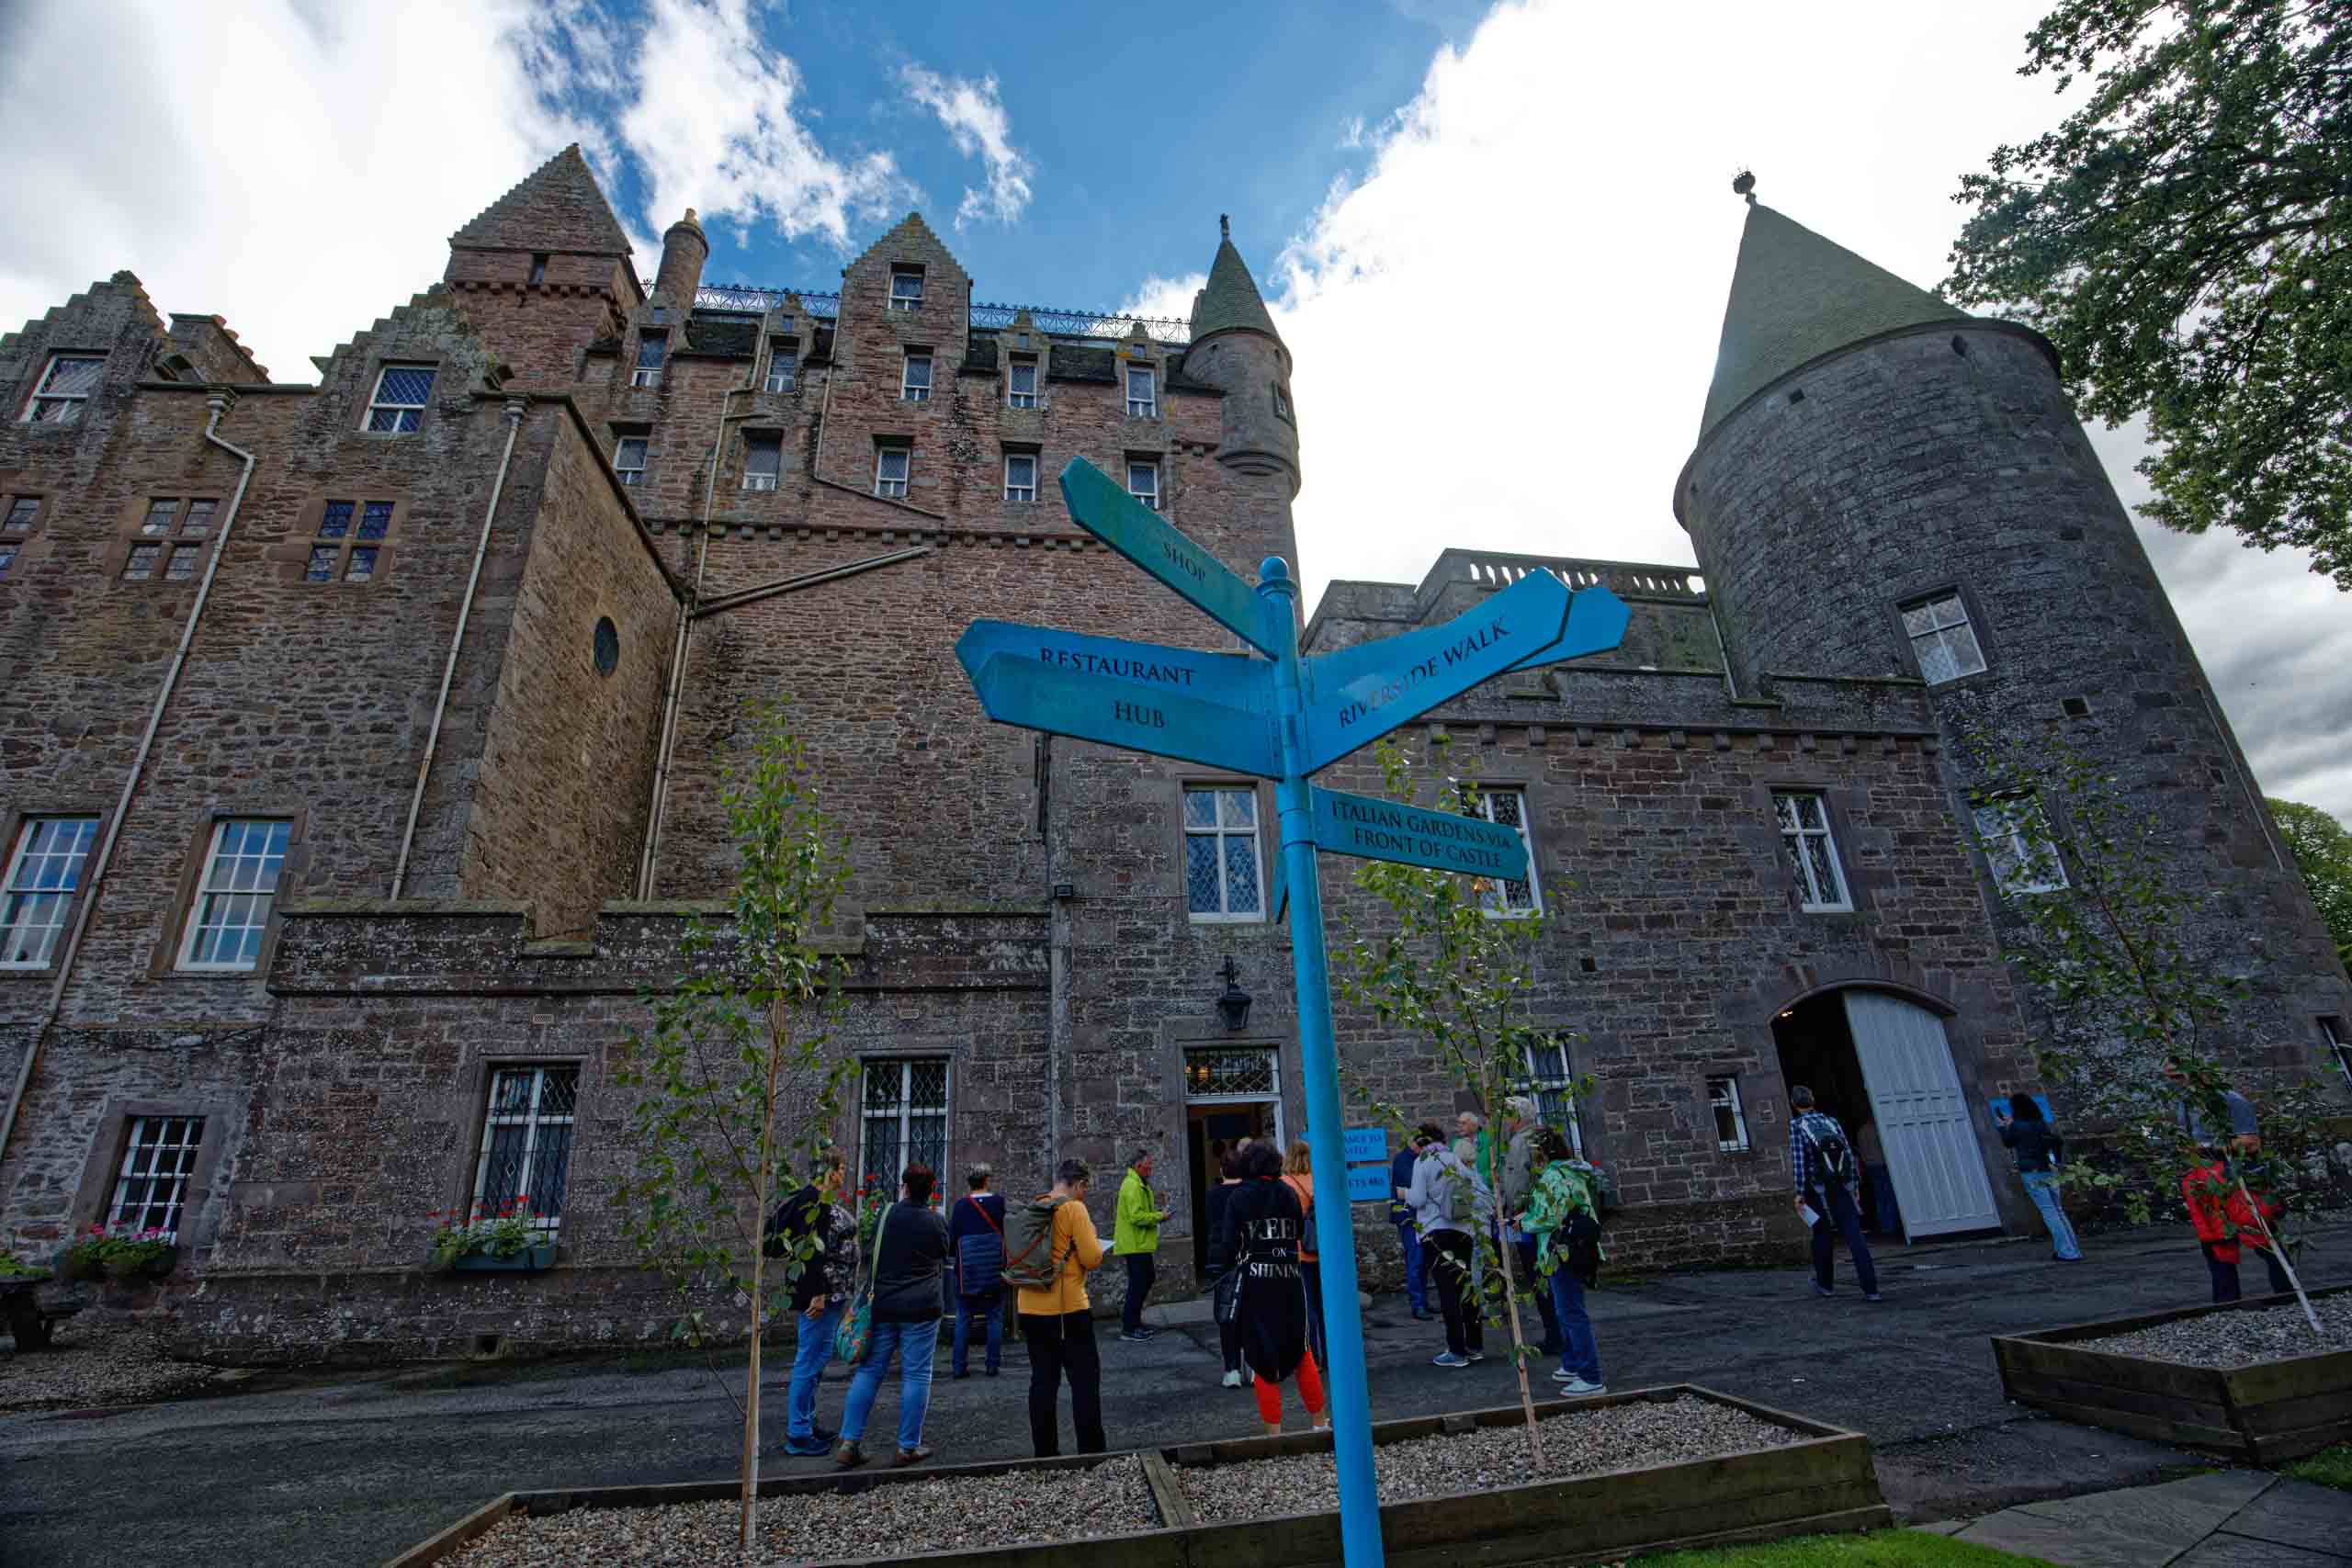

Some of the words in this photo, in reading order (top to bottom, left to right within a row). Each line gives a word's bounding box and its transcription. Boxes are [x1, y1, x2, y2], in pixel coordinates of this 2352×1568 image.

[1162, 542, 1206, 581] SHOP
[1040, 647, 1196, 685] RESTAURANT
[1339, 656, 1438, 728] RIVERSIDE
[1443, 615, 1511, 667] WALK
[1114, 700, 1165, 728] HUB
[1332, 800, 1402, 829] ITALIAN
[1407, 815, 1485, 844] GARDENS
[1487, 833, 1512, 850] VIA
[1353, 828, 1413, 853] FRONT
[1419, 840, 1442, 859] OF
[1446, 844, 1501, 868] CASTLE
[1272, 1247, 1287, 1258] ON
